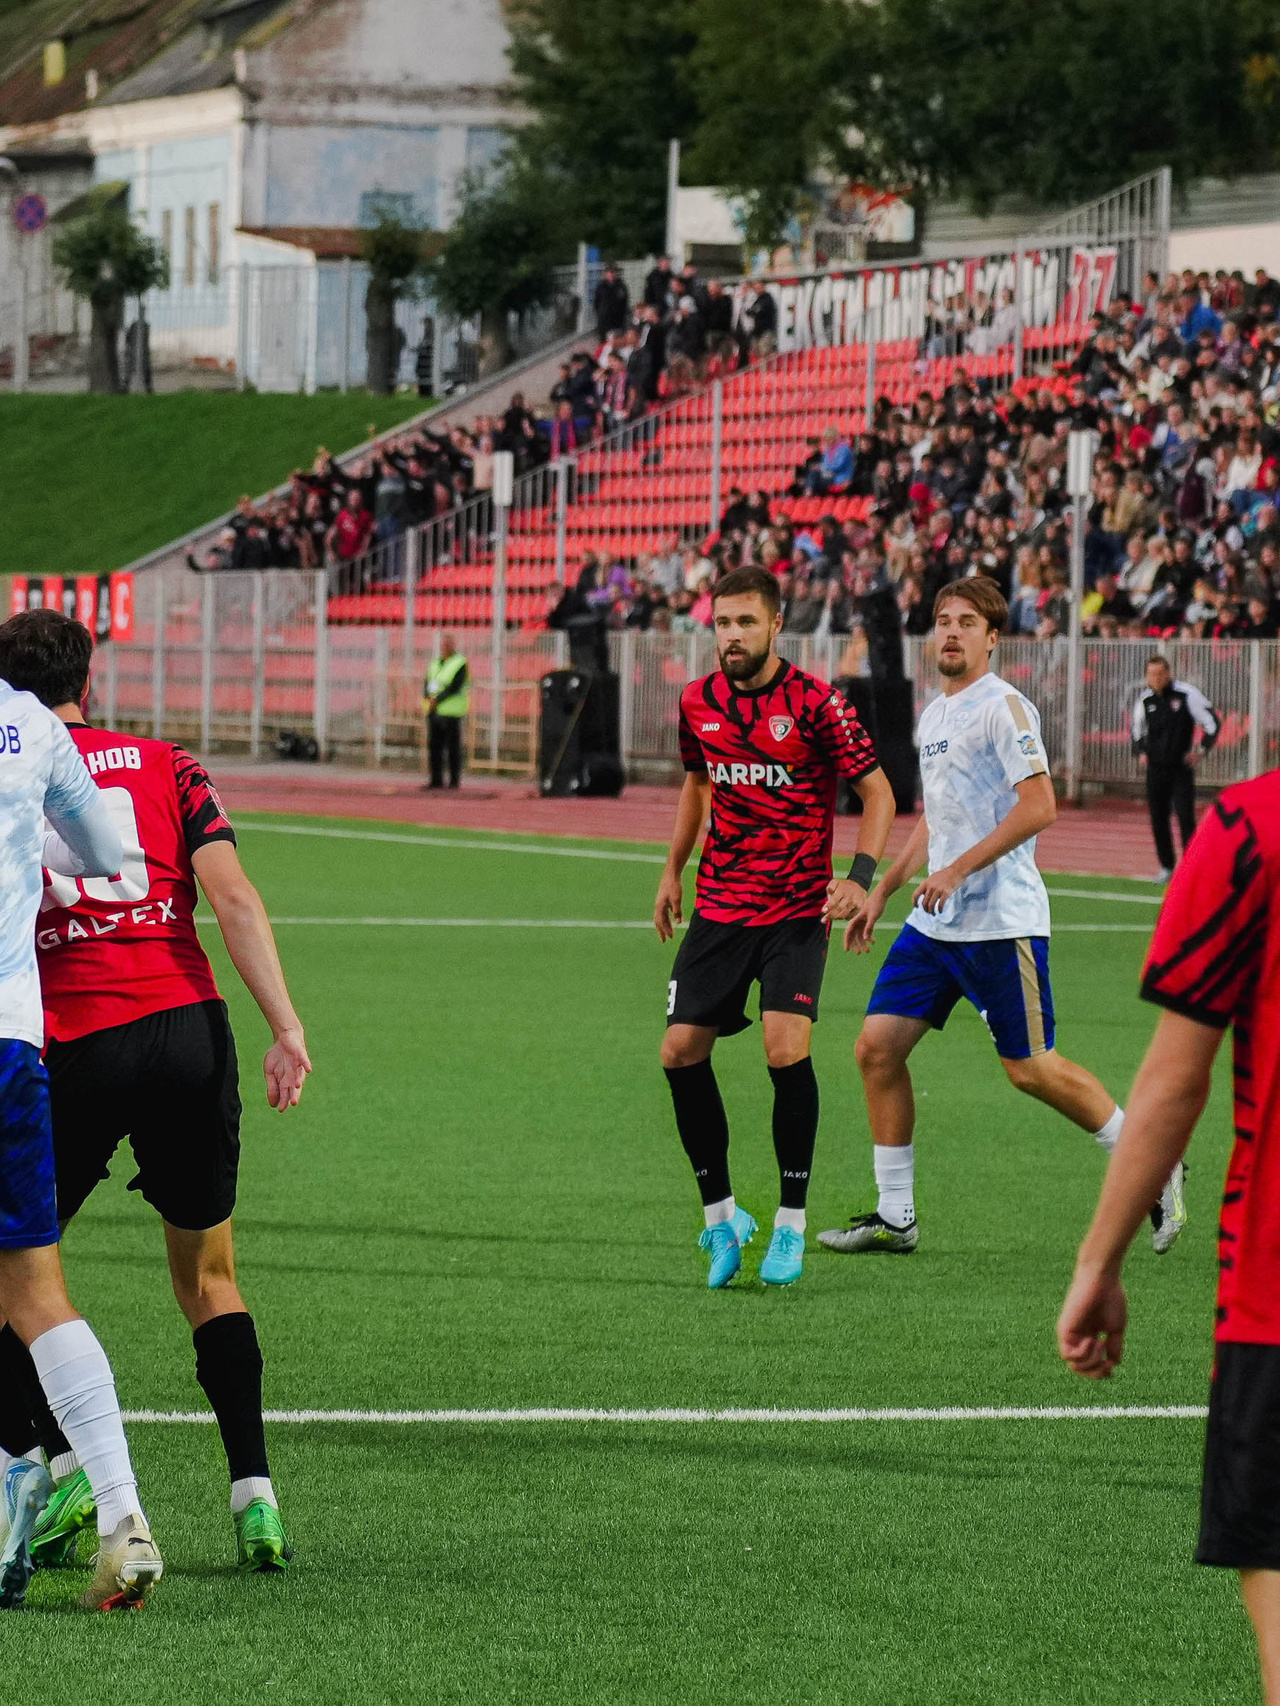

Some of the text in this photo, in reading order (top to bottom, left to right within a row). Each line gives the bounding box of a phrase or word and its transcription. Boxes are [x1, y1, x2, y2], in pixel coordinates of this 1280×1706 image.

[702, 723, 720, 732] JAKO
[706, 760, 794, 787] GARPIX
[793, 992, 814, 1006] JAKO
[783, 1170, 809, 1180] JAKO
